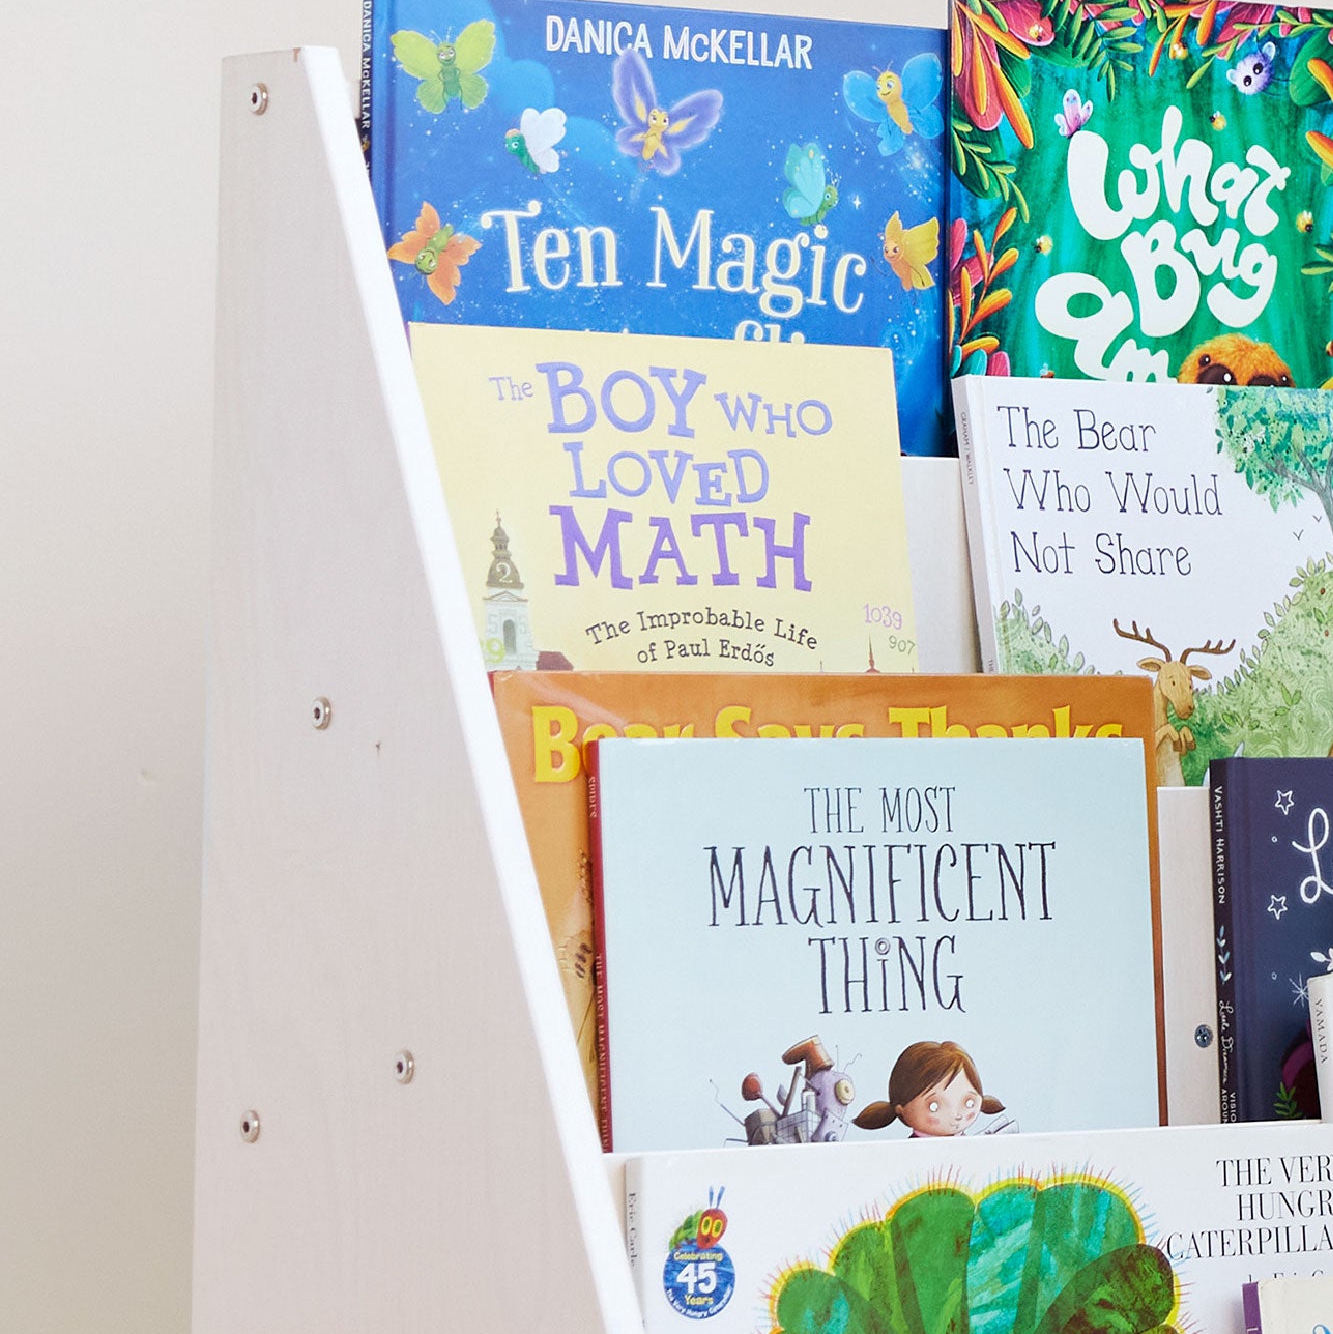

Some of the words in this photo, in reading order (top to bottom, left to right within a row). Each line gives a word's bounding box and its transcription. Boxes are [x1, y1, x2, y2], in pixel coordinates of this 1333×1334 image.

[362, 0, 372, 52] DANICA
[545, 13, 653, 59] DANICA
[1066, 104, 1292, 241] What
[480, 198, 624, 295] Ten
[645, 205, 868, 320] Magic
[1120, 219, 1279, 338] Bug
[487, 375, 534, 402] The
[534, 360, 707, 439] BOY
[713, 390, 835, 439] WHO
[996, 403, 1060, 451] The
[1075, 407, 1157, 454] Bear
[561, 440, 771, 508] LOVED
[1003, 467, 1093, 514] Who
[1103, 468, 1224, 517] Would
[548, 504, 814, 593] MATH
[1009, 530, 1077, 576] Not
[1093, 530, 1192, 578] Share
[584, 620, 632, 646] The
[635, 606, 766, 639] Improbable
[773, 617, 819, 652] Life
[863, 602, 903, 631] 1039
[635, 643, 658, 666] of
[664, 637, 713, 661] Paul
[717, 638, 776, 669] Erdős
[888, 634, 917, 656] 907
[802, 786, 865, 835] THE
[880, 785, 957, 835] MOST
[1214, 786, 1223, 832] VASHTI
[703, 839, 1057, 930] MAGNIFICENT
[1216, 838, 1225, 904] HARRISON
[1315, 998, 1328, 1064] YAMADA
[1215, 1156, 1273, 1188] THE
[673, 1251, 723, 1261] Celebrating
[674, 1261, 718, 1295] 45
[684, 1294, 714, 1306] Years
